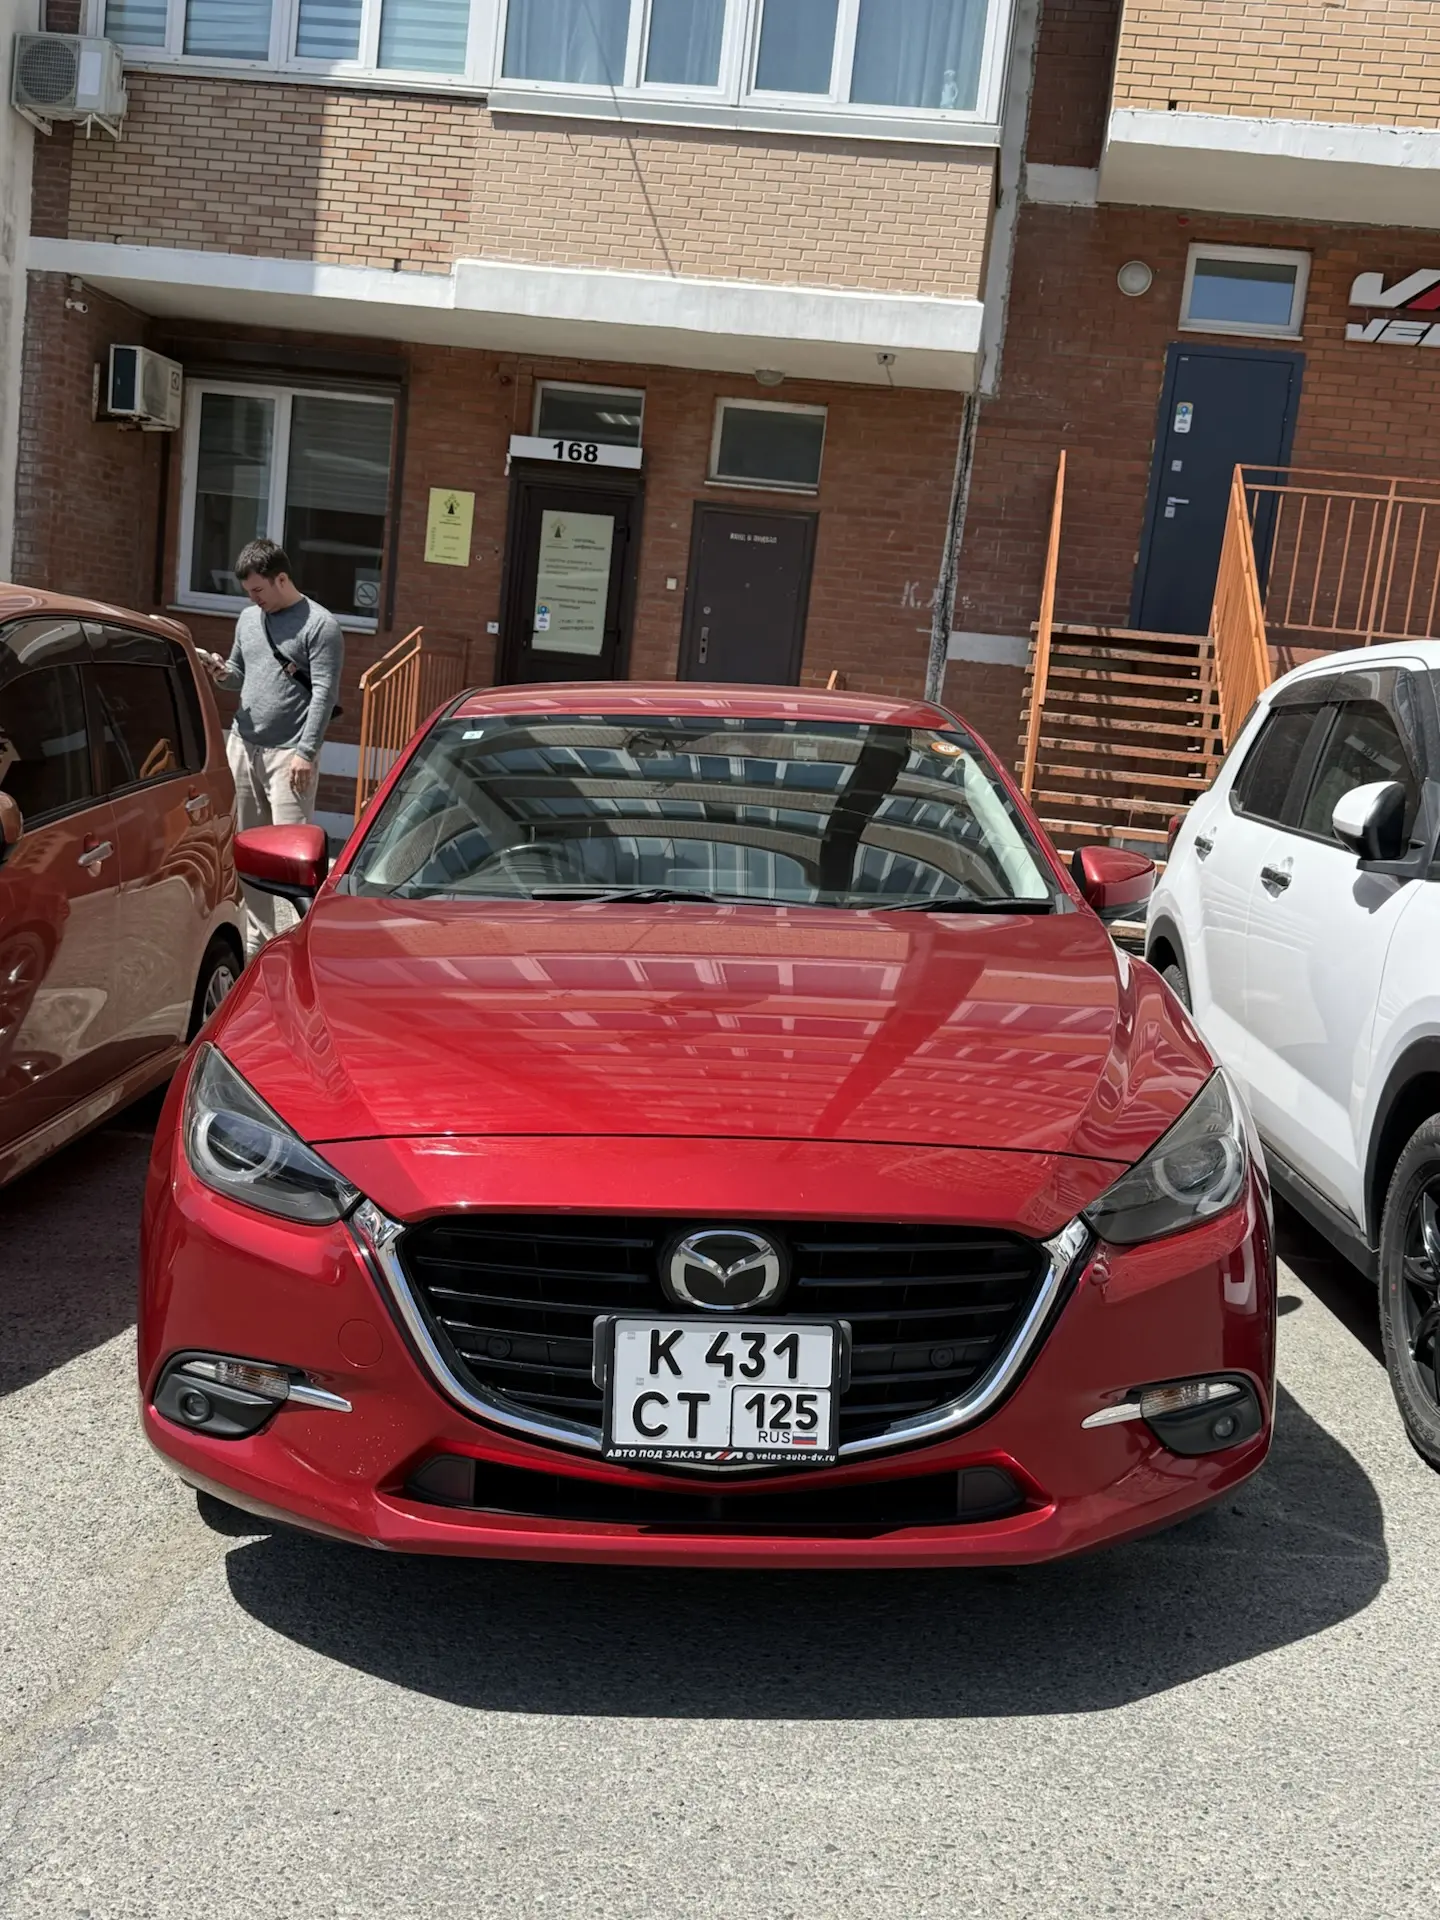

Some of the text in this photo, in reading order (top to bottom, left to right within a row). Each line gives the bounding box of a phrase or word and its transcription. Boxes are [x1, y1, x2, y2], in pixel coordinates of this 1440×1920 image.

[552, 441, 599, 463] 168
[649, 1330, 799, 1380] К 431
[632, 1391, 818, 1439] СТ 125
[758, 1431, 791, 1444] RUS
[606, 1449, 702, 1459] АВТО ПОД ЗАКАЗ
